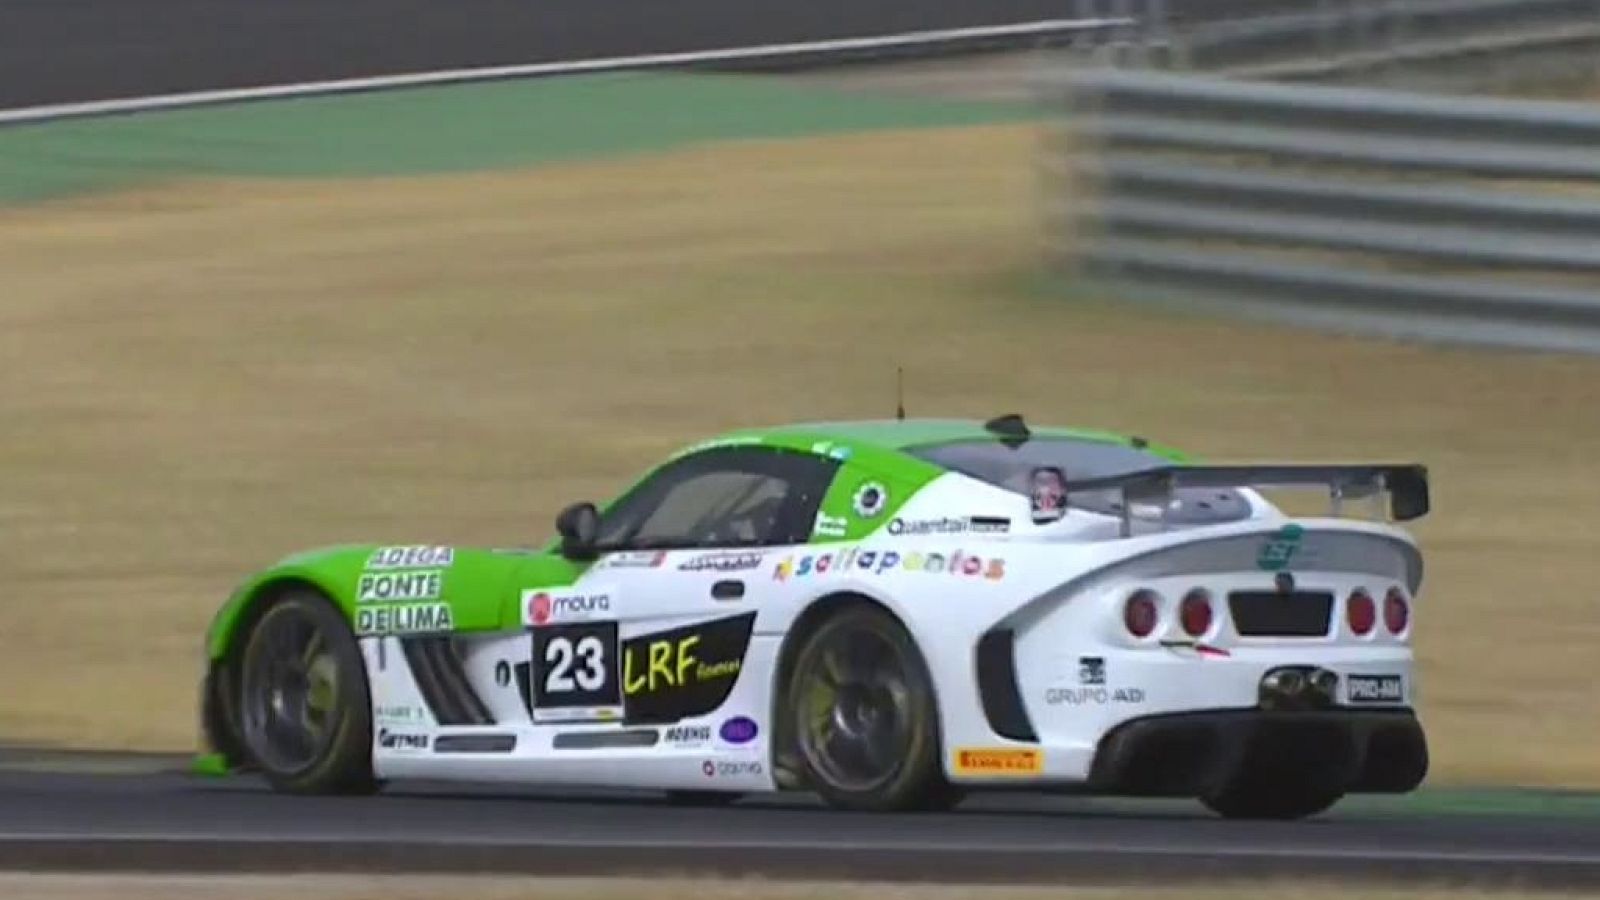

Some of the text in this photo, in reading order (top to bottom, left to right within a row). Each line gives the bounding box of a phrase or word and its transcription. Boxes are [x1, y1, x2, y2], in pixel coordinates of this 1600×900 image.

[368, 547, 452, 565] ADEGA
[360, 574, 439, 597] PONTE
[552, 595, 610, 615] moura
[358, 606, 451, 632] DE LIMA
[545, 635, 606, 693] 23
[623, 635, 700, 695] LRF
[1045, 688, 1107, 705] GRUPO
